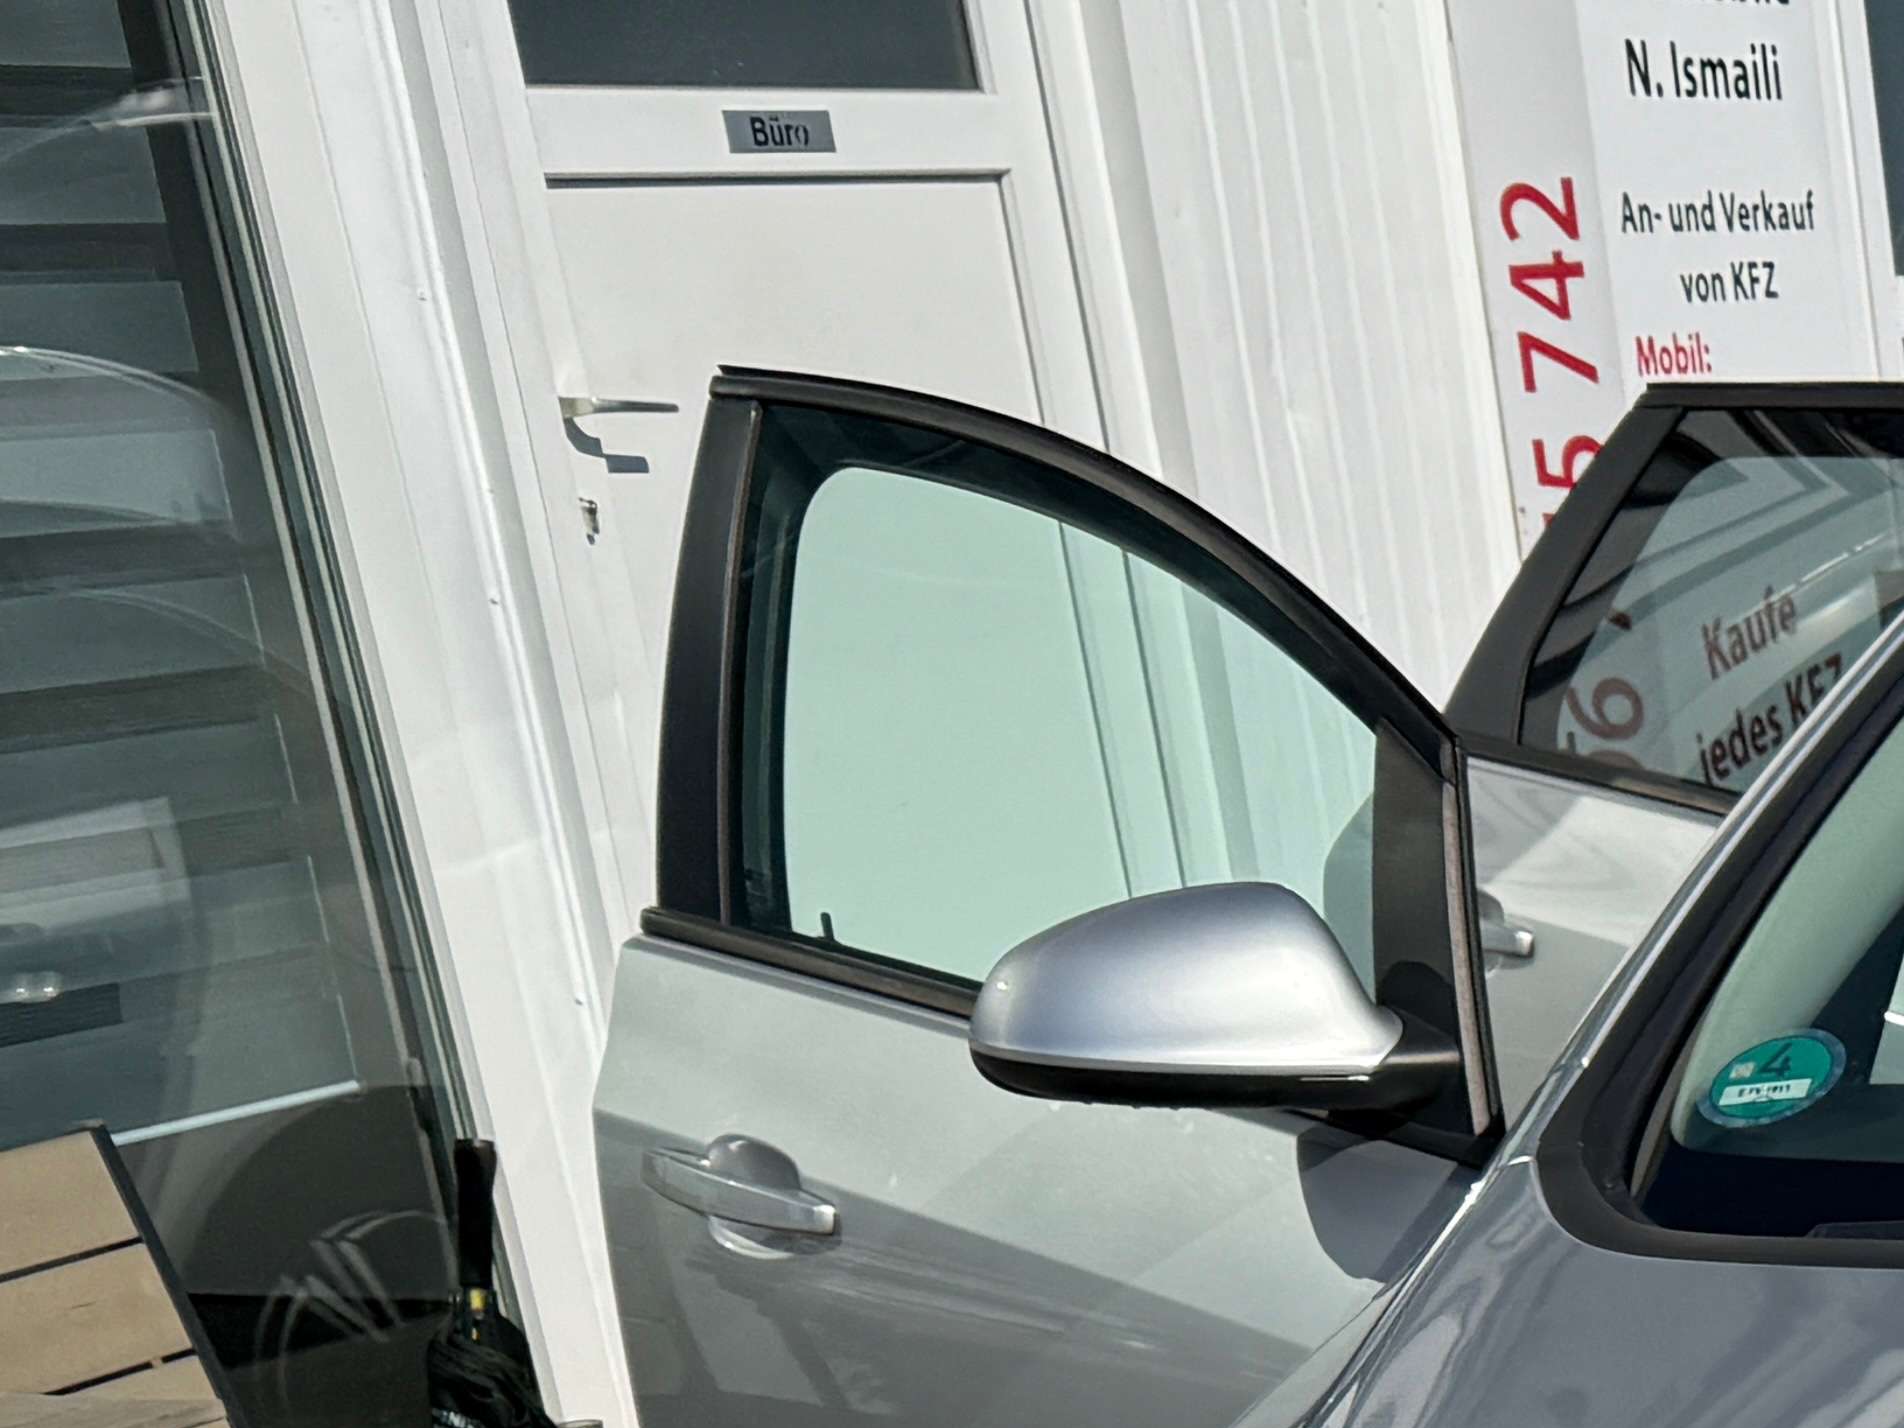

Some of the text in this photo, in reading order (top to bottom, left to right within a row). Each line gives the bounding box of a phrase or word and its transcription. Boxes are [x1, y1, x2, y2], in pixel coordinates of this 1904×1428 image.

[1625, 38, 1783, 100] N. Ismaili
[750, 116, 809, 146] Büro
[1621, 189, 1815, 233] An- und Verkauf
[1680, 261, 1779, 303] von KFZ
[1635, 332, 1712, 376] Mobil:
[1701, 585, 1797, 680] Kaufe
[1696, 706, 1783, 786] jedes
[1759, 1042, 1793, 1079] 4
